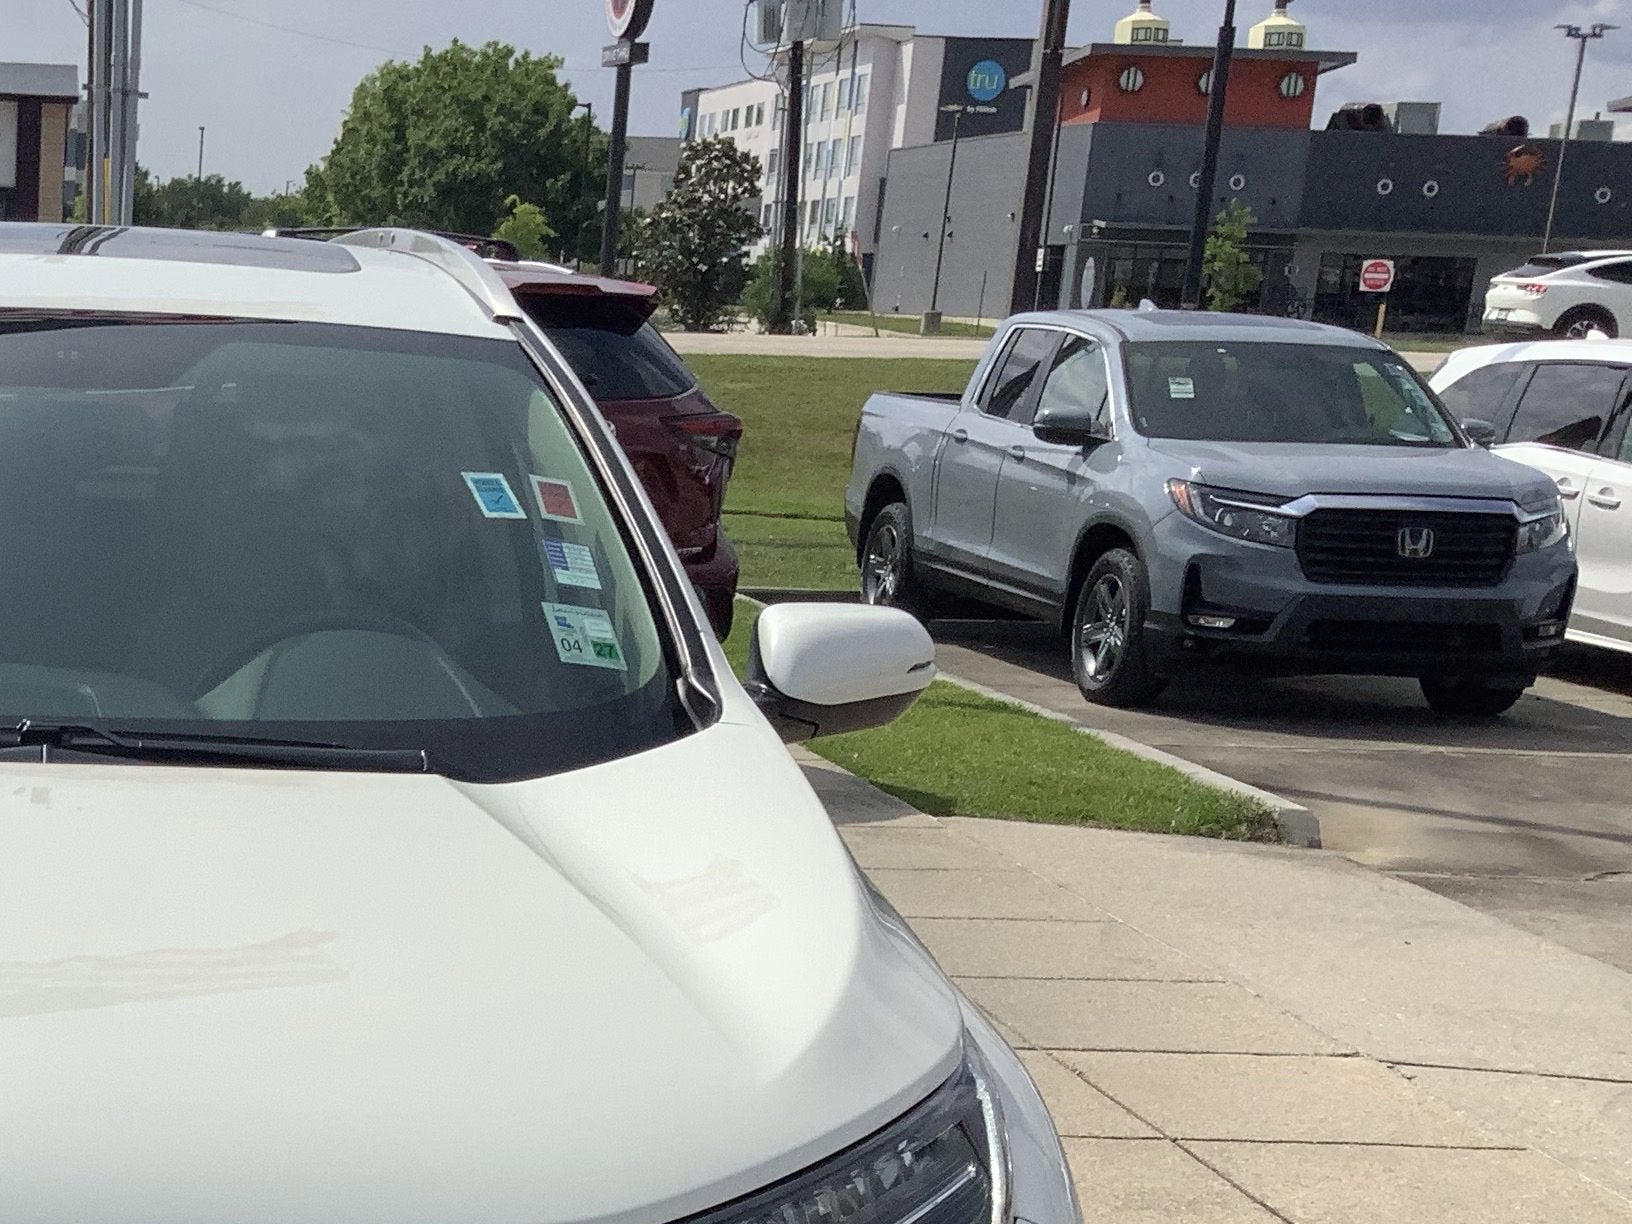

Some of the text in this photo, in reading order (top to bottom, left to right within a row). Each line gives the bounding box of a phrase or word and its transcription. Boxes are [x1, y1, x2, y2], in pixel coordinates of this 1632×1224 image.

[969, 70, 998, 90] tru
[560, 637, 614, 658] 04 27
